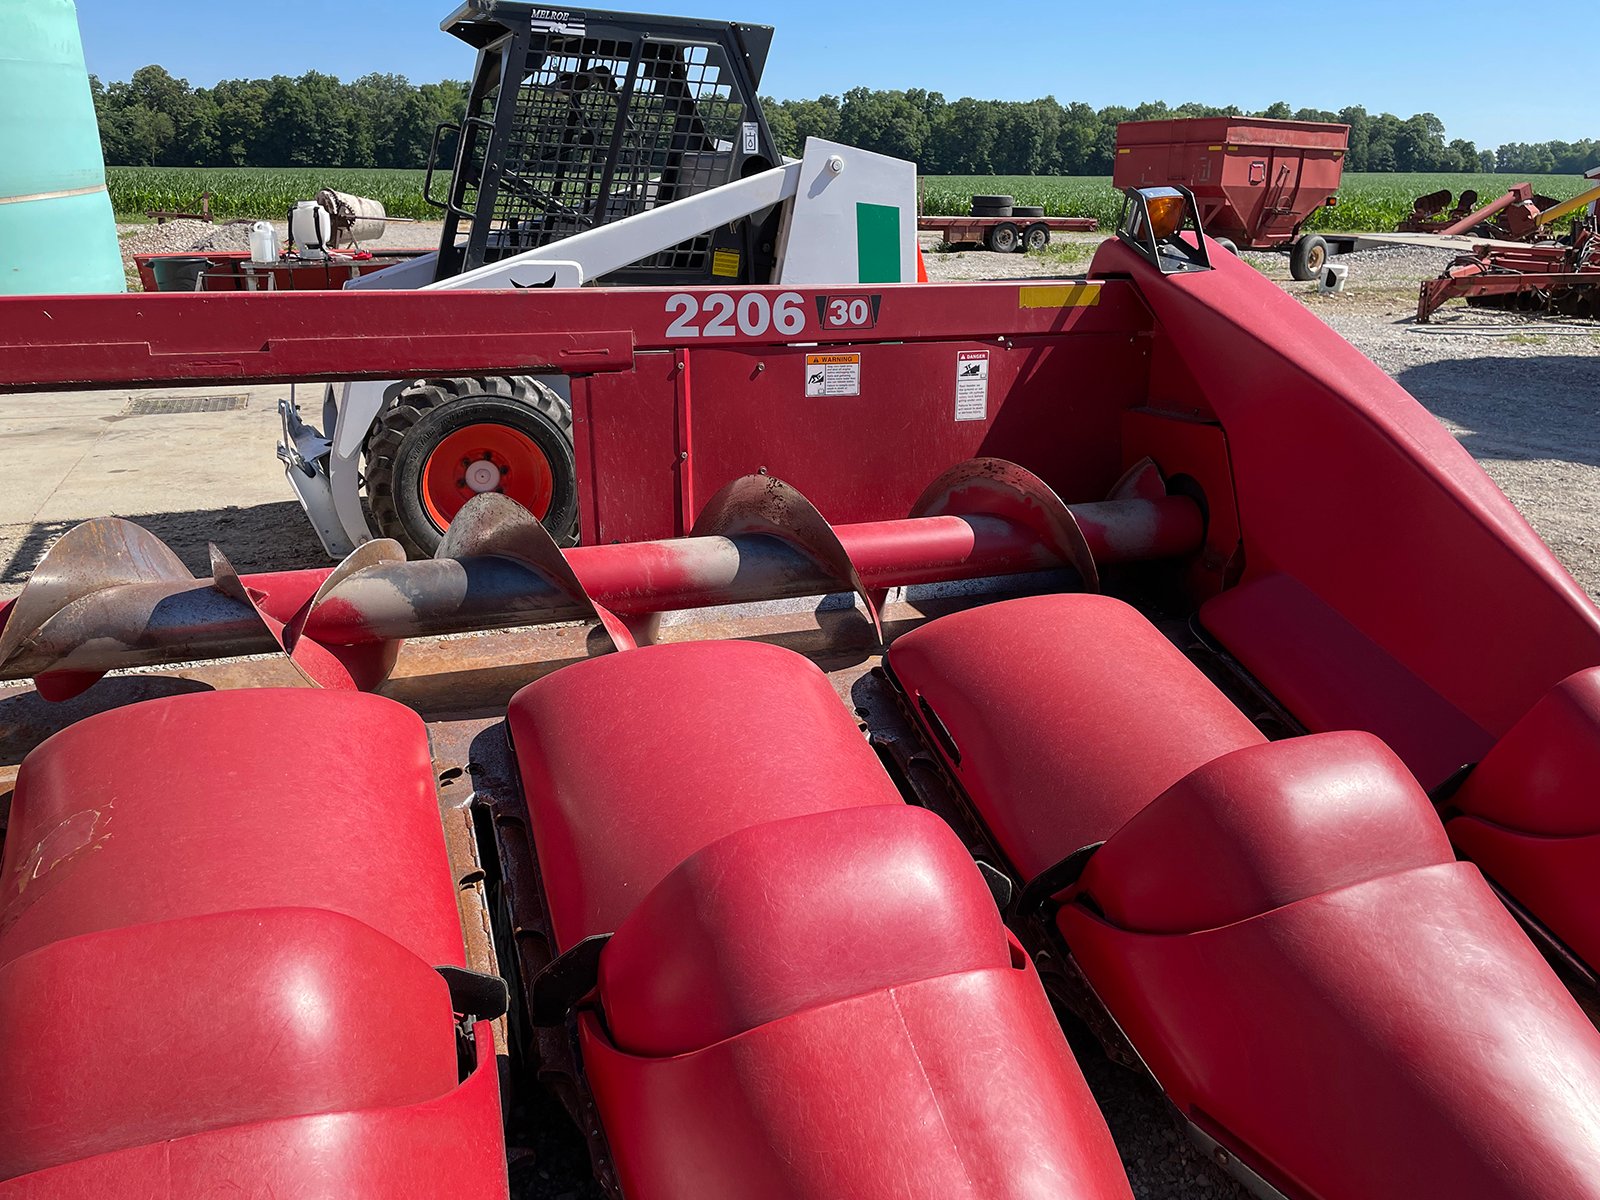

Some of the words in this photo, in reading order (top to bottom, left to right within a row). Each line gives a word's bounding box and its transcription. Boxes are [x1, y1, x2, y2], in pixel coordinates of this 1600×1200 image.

[531, 9, 569, 21] MELROE
[665, 292, 806, 337] 2206
[829, 299, 869, 326] 30
